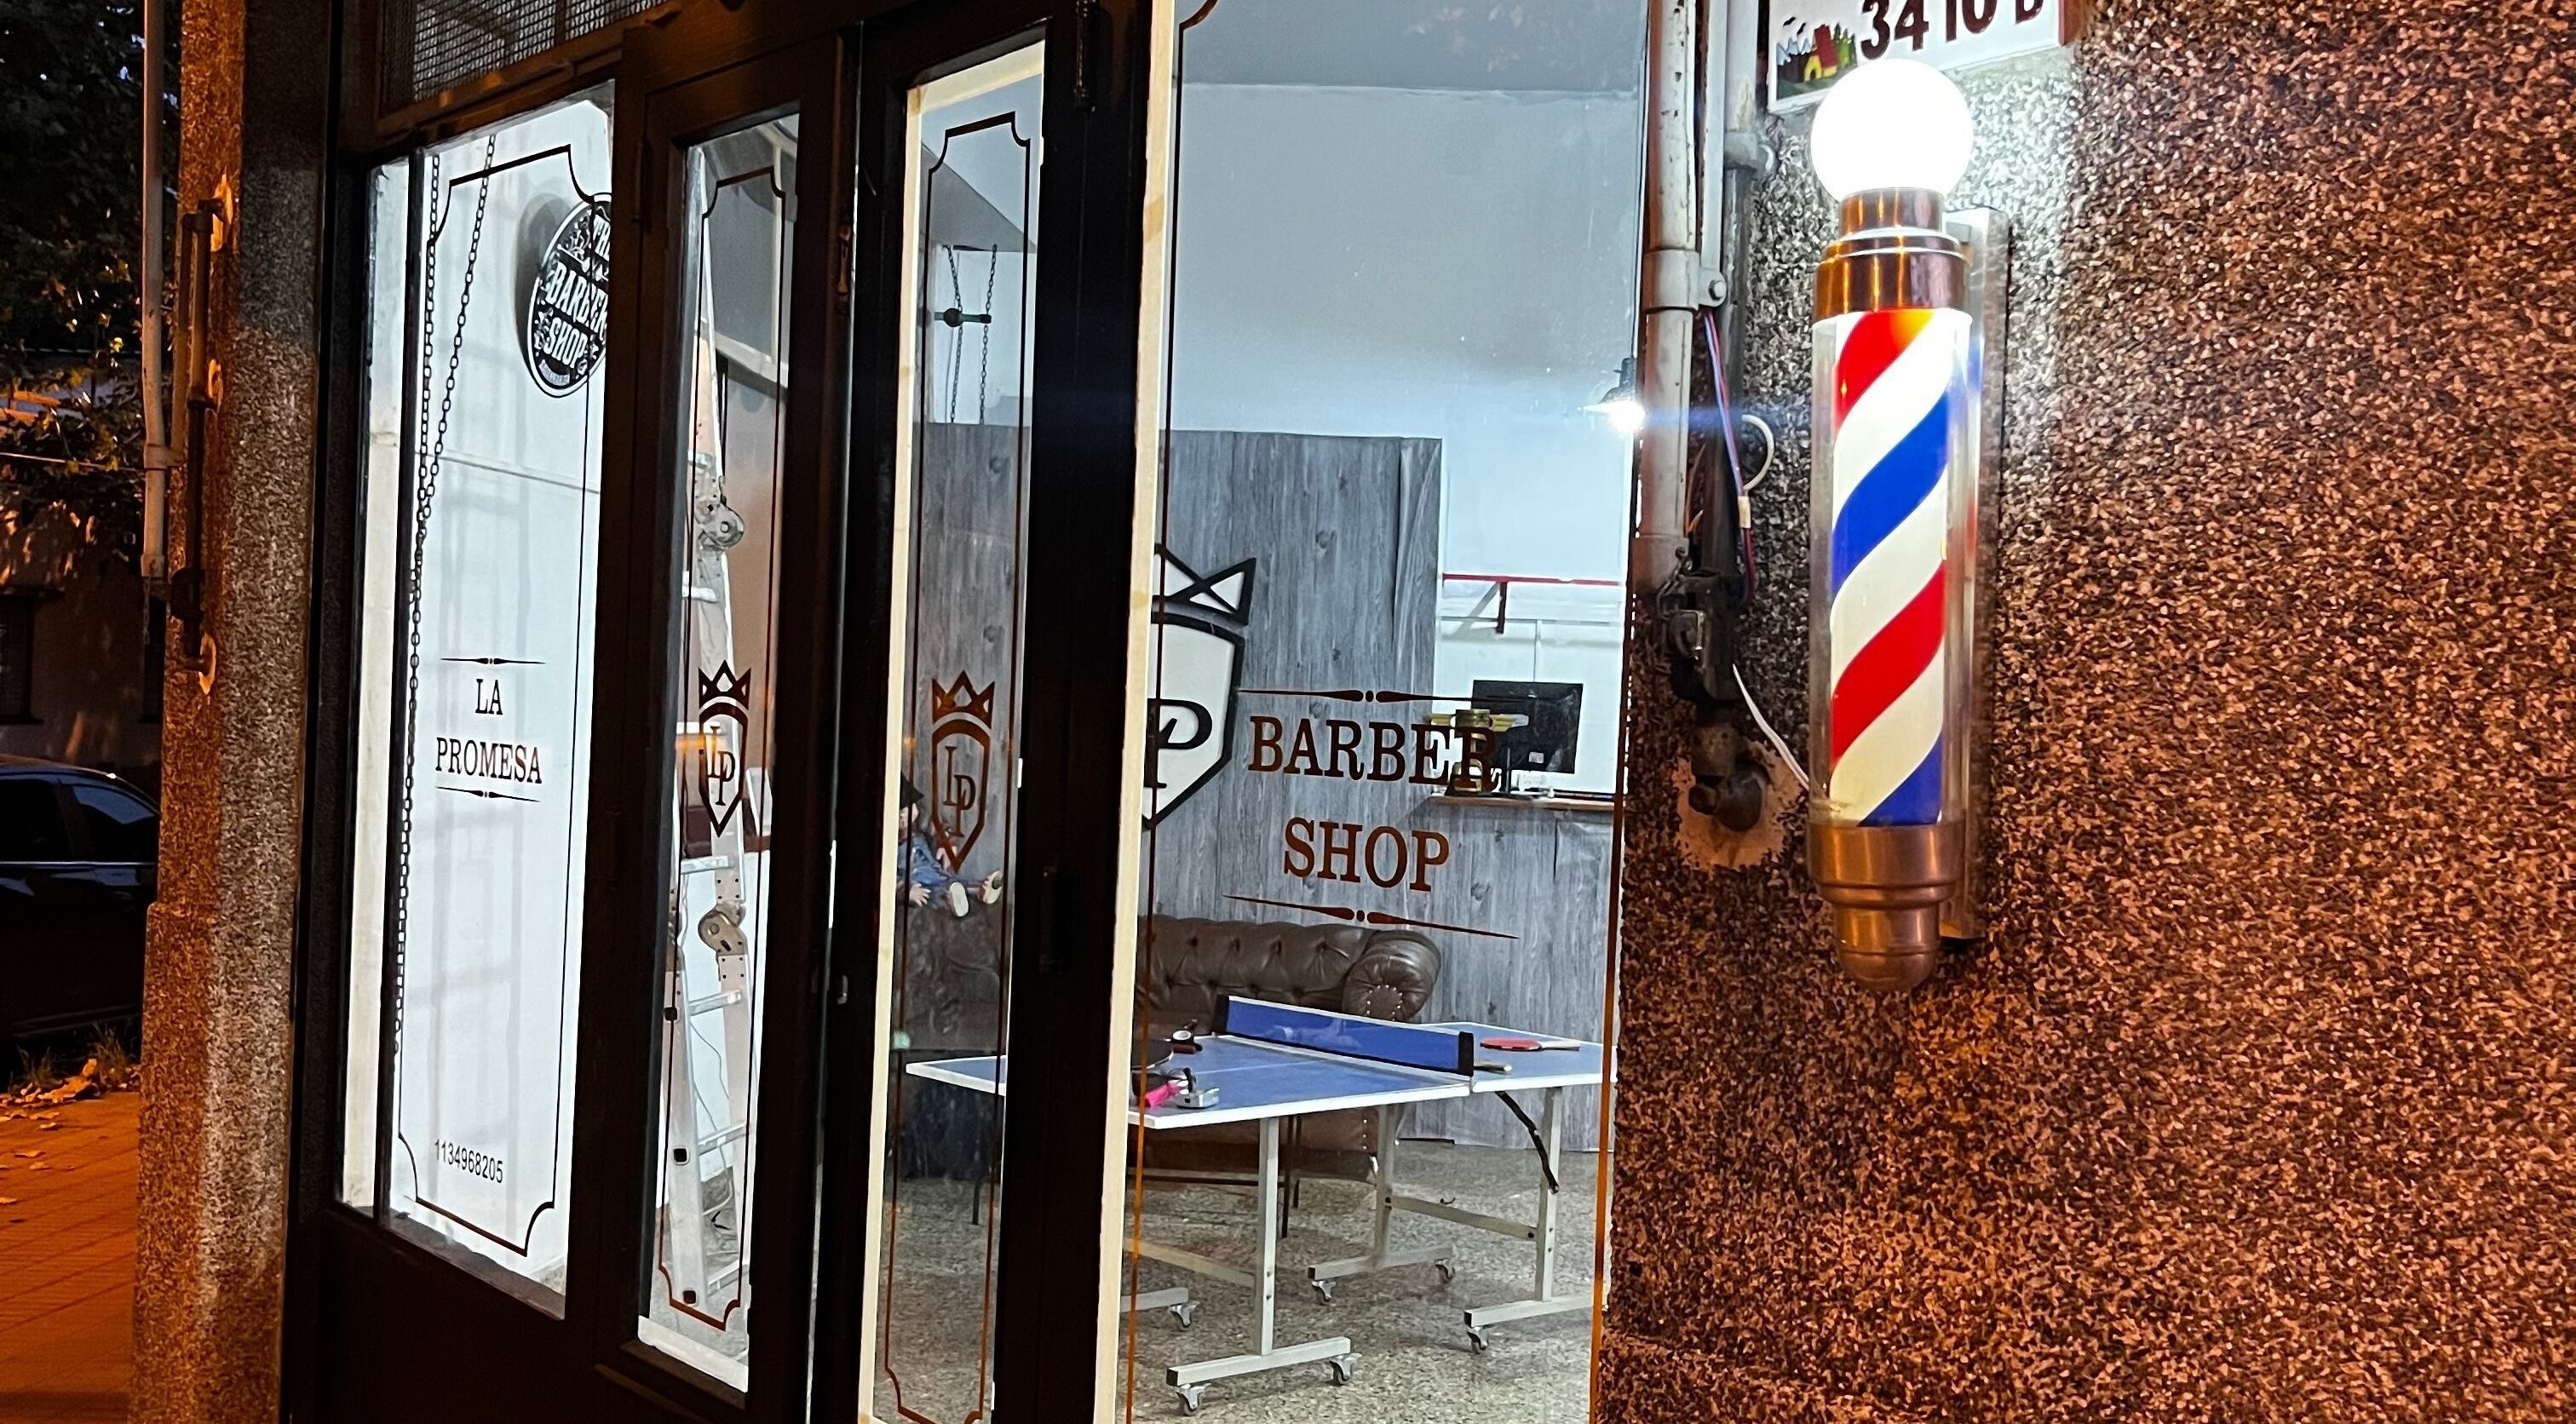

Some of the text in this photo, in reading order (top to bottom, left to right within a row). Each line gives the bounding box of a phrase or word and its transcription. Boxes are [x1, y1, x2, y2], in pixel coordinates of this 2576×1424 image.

[543, 317, 589, 369] SHOP
[475, 679, 503, 715] LA
[435, 737, 543, 784] PROMESA
[1144, 698, 1213, 789] P
[1247, 715, 1500, 792] BARBER
[1284, 817, 1450, 893] SHOP
[434, 1139, 503, 1184] 1134968205
